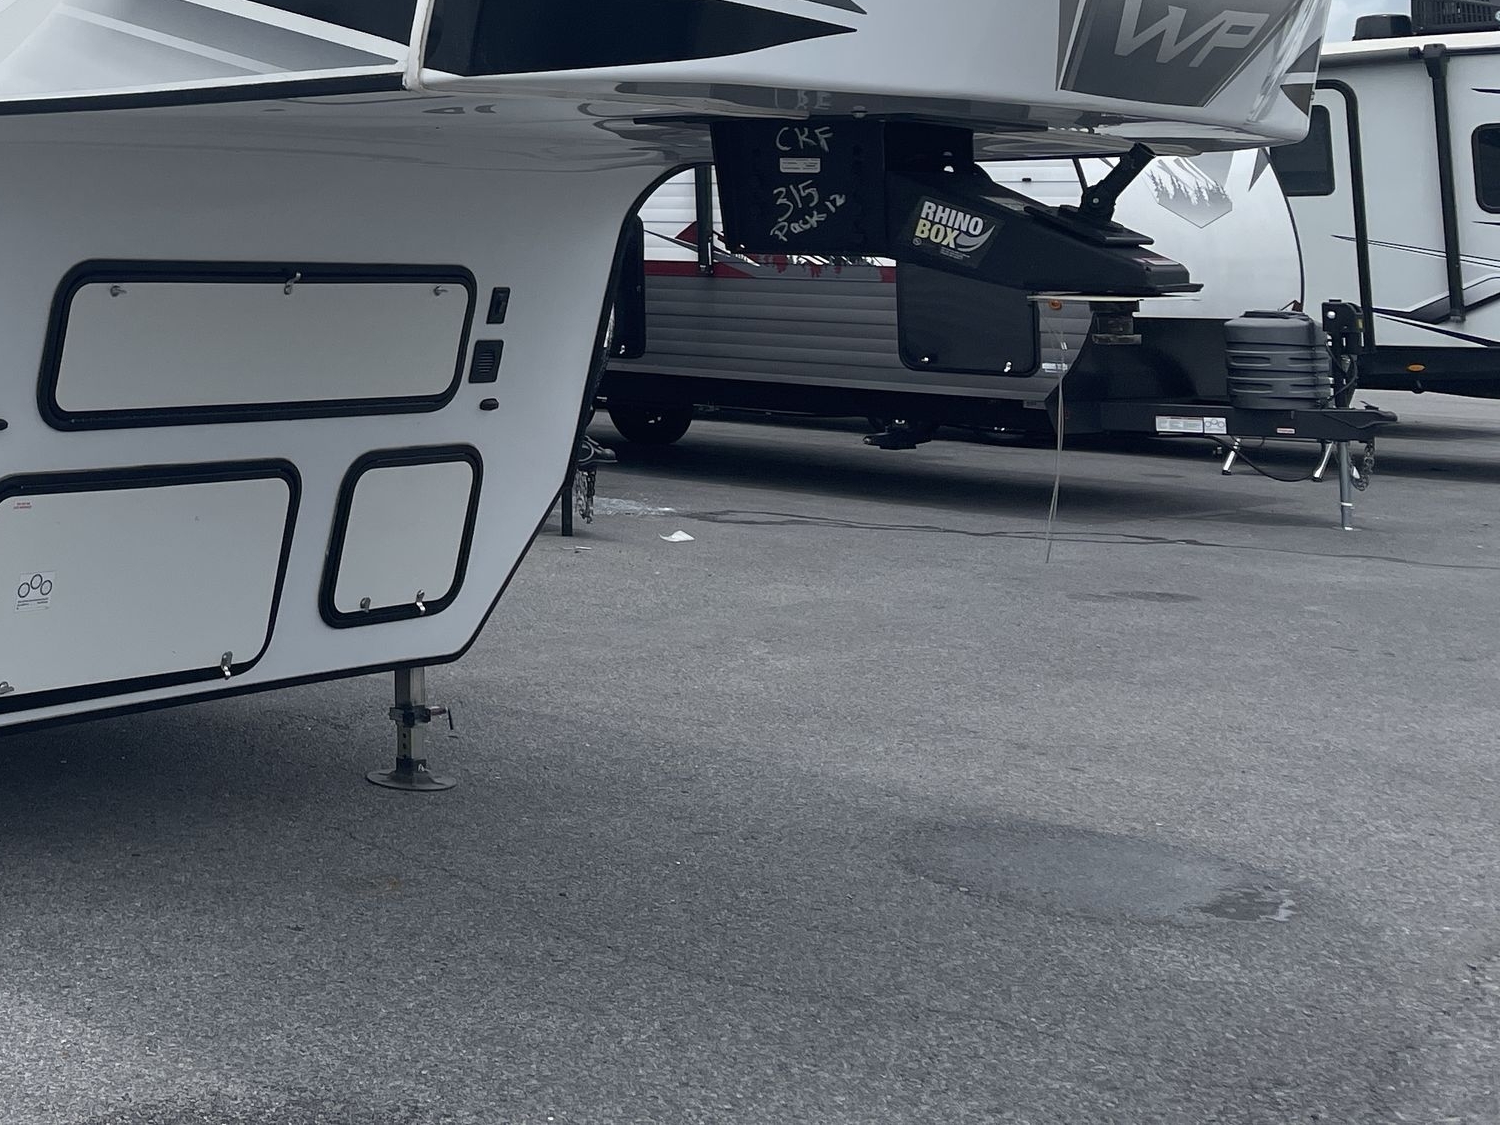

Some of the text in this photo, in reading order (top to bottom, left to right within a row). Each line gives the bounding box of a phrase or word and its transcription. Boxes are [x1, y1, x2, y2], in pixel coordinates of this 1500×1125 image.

[775, 126, 834, 153] CKF
[772, 179, 820, 223] 315
[914, 218, 960, 249] BOX
[920, 200, 984, 236] RHINO
